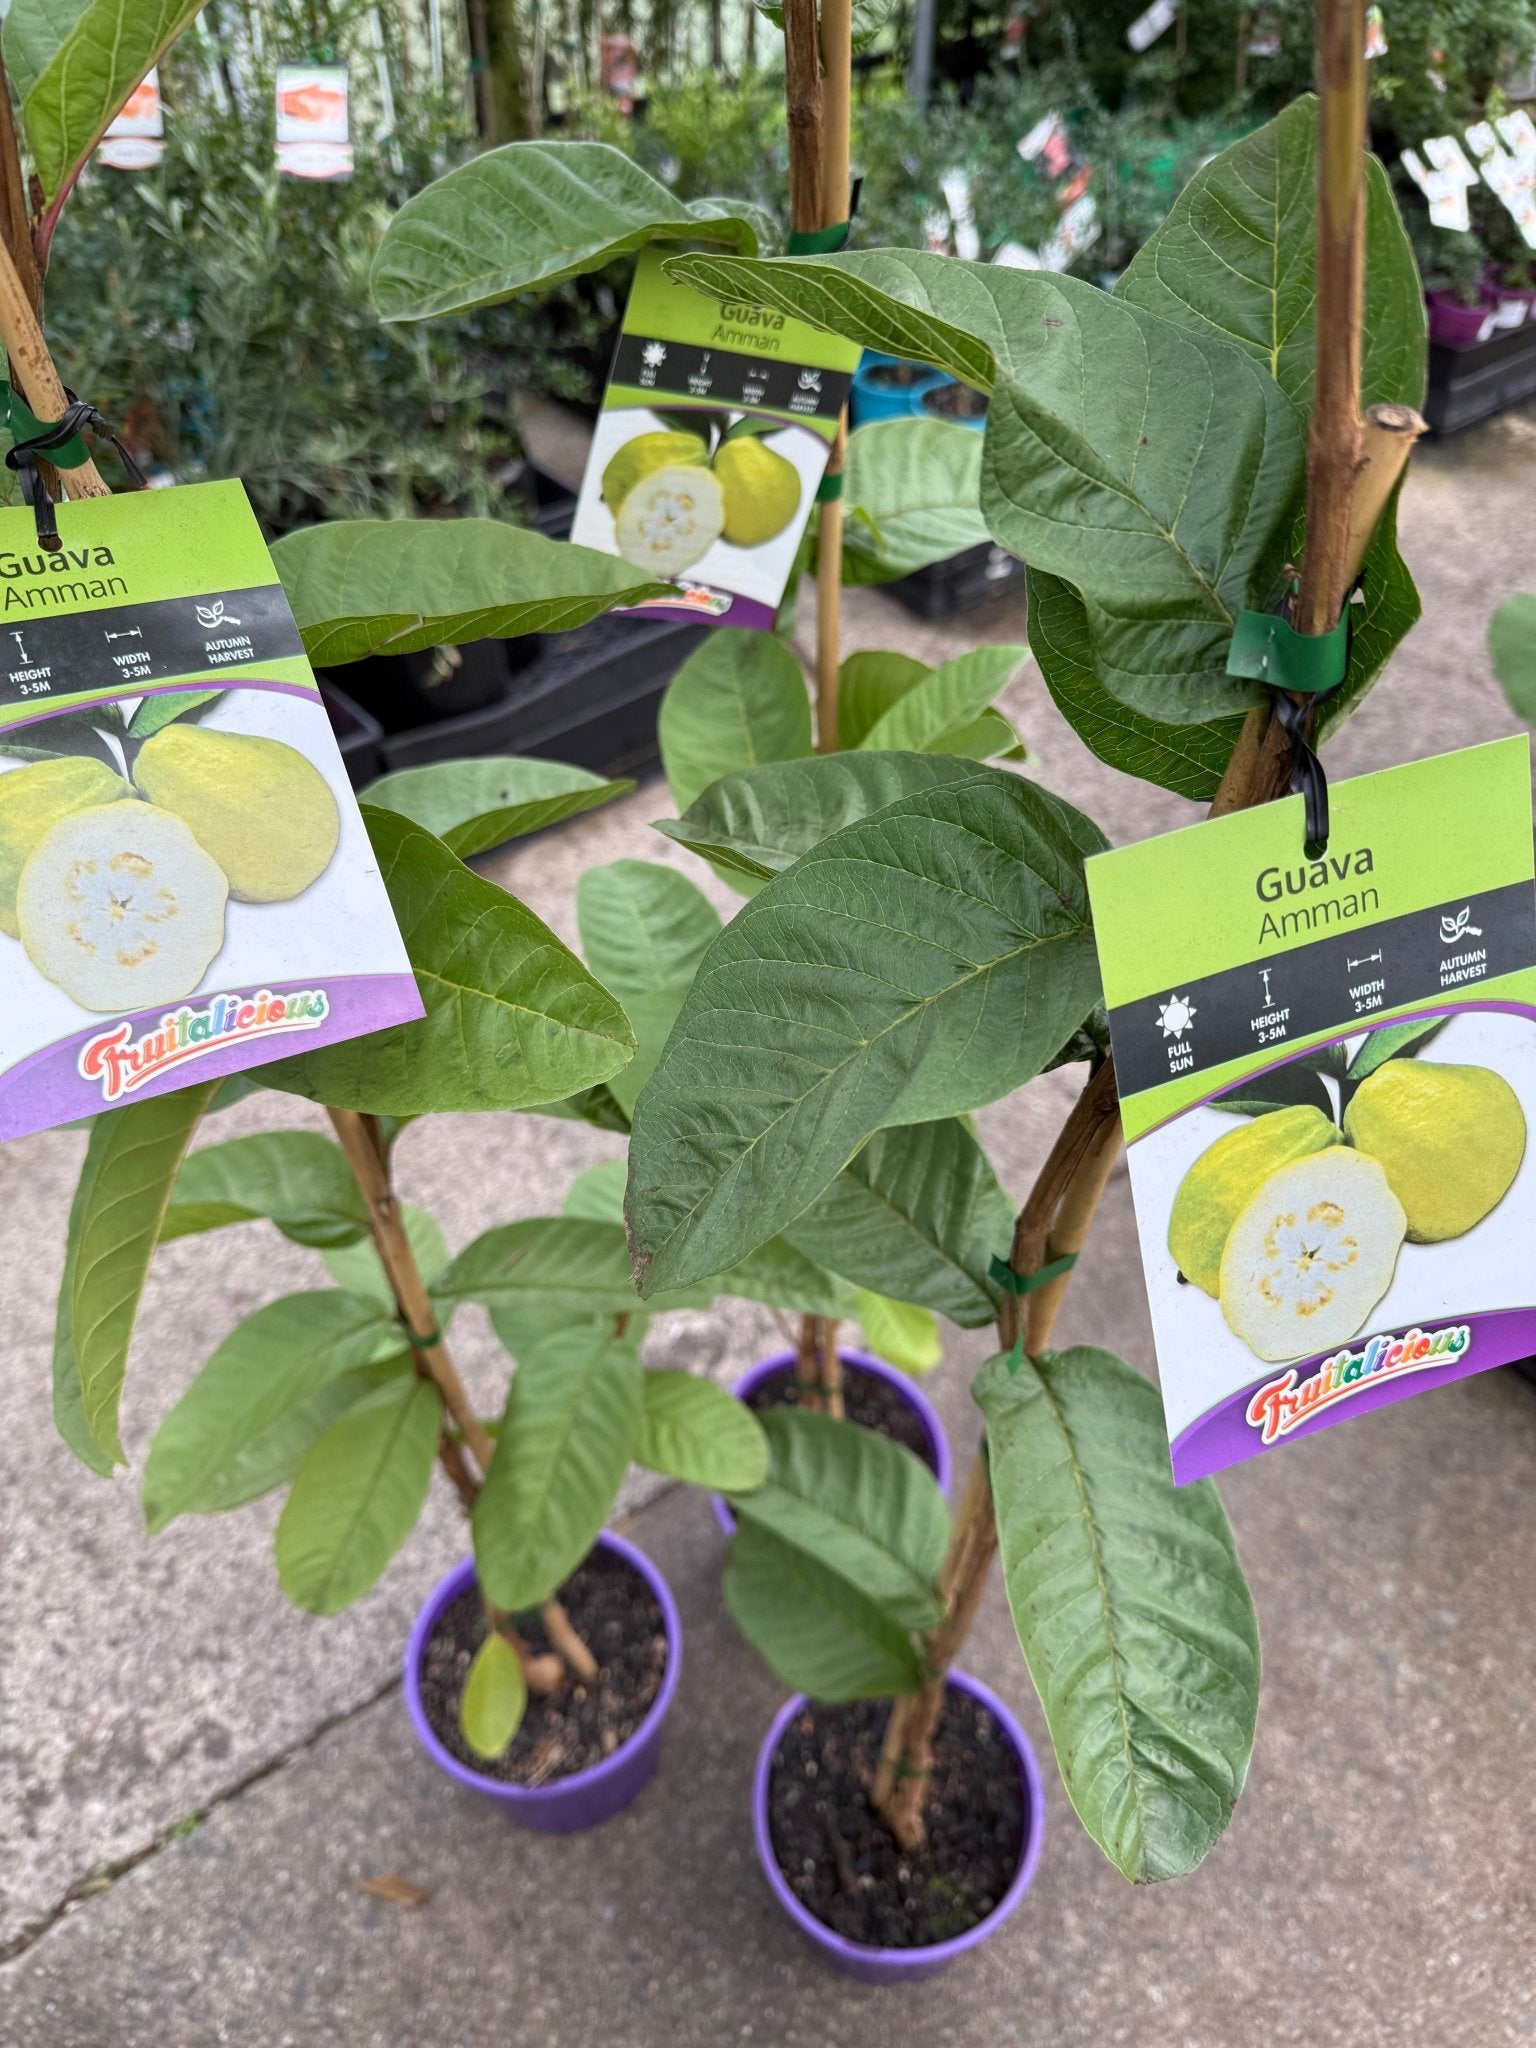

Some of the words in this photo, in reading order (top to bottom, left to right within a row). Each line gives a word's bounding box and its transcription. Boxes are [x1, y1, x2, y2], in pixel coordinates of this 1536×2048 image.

[711, 325, 781, 352] Amman
[0, 546, 115, 579] Guava
[5, 577, 128, 611] Amman
[204, 636, 251, 653] AUTUMN
[112, 652, 151, 668] WIDTH
[208, 648, 255, 664] HARVEST
[9, 667, 52, 683] HEIGHT
[122, 665, 152, 679] 3-5M
[20, 681, 52, 695] 3-5M
[1255, 846, 1375, 903] Guava
[1258, 887, 1379, 945] Amman
[1439, 949, 1487, 972] AUTUMN
[1440, 963, 1488, 987] HARVEST
[1349, 979, 1386, 999] WIDTH
[1354, 995, 1383, 1013] 3-5M
[1250, 1008, 1291, 1031] HEIGHT
[82, 992, 327, 1097] Fruitalicious
[1257, 1026, 1287, 1044] 3-5M
[1167, 1041, 1193, 1060] FULL
[1169, 1057, 1194, 1075] SUN
[1249, 1328, 1468, 1440] Fruitalicious
